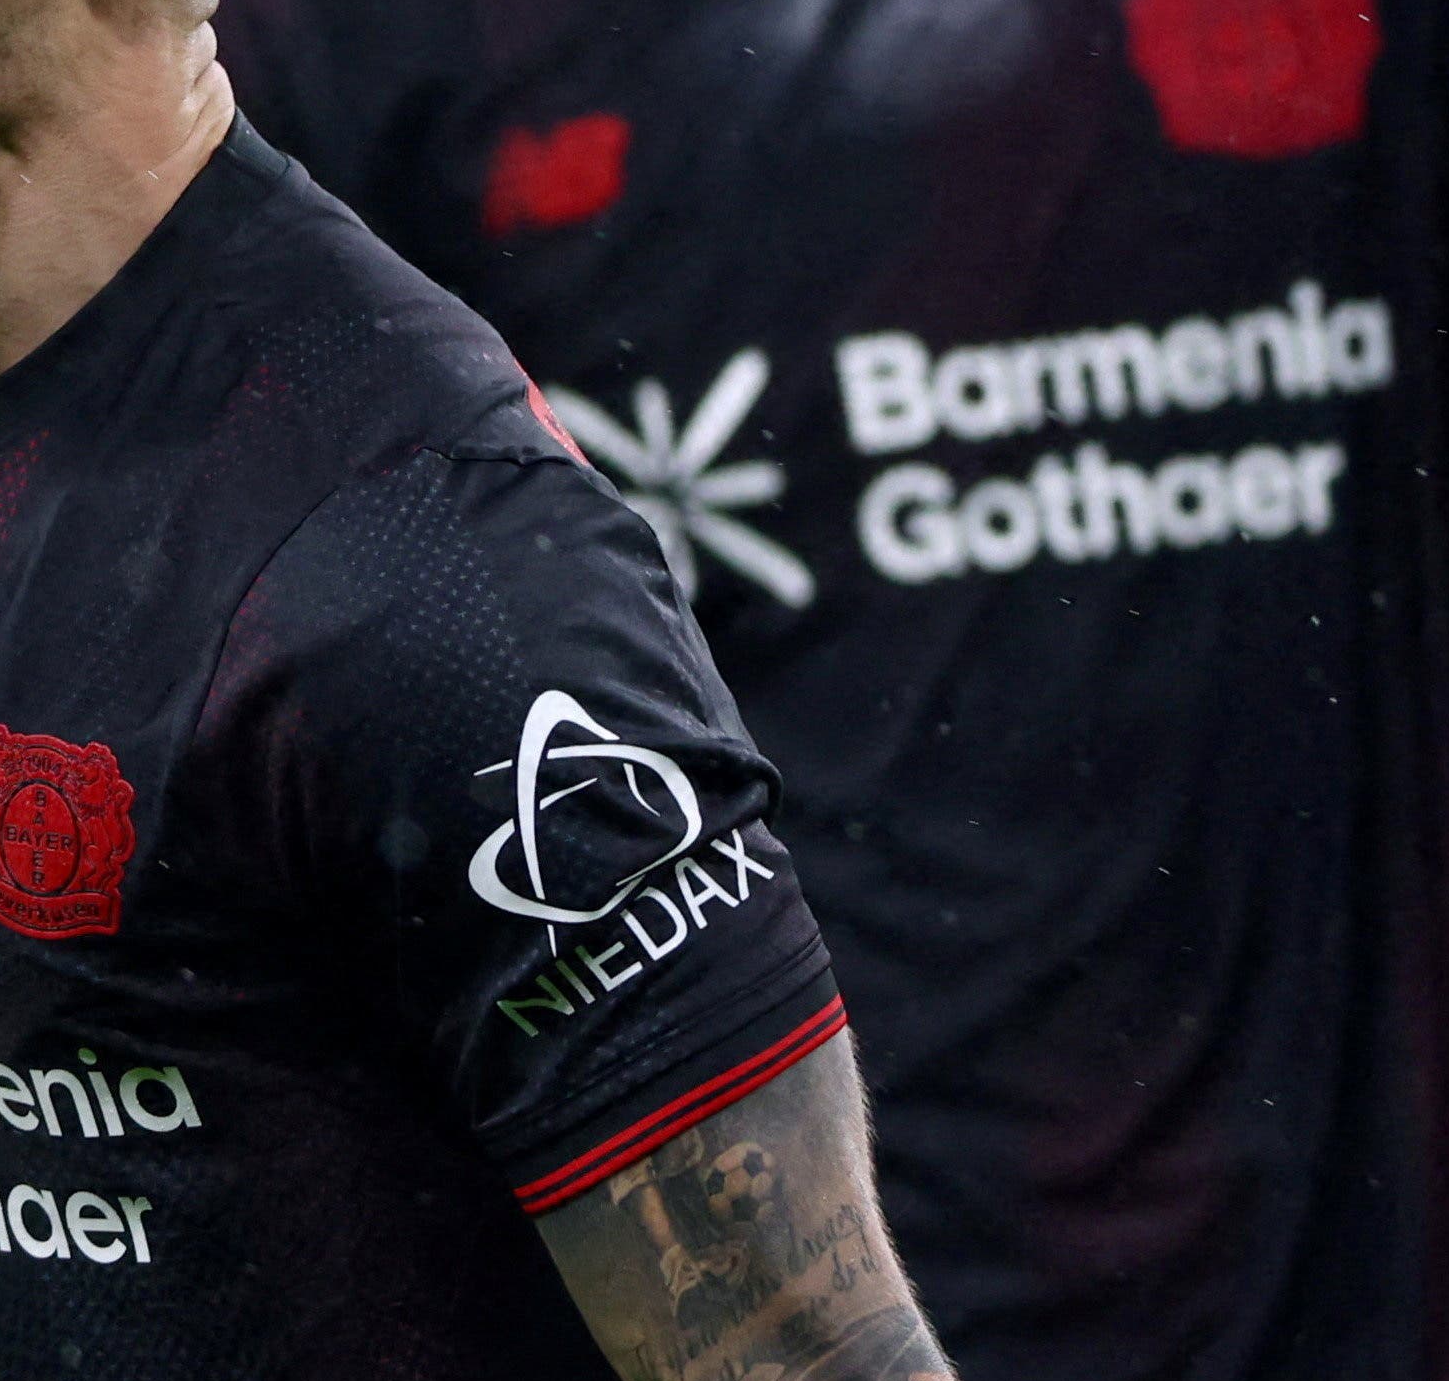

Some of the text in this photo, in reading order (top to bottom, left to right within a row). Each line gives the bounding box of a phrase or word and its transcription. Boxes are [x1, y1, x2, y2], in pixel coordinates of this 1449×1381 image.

[835, 279, 1394, 455] Barmenia
[857, 441, 1348, 585] Gothaer
[4, 824, 74, 851] BAYER
[497, 828, 775, 1038] NIEDAX
